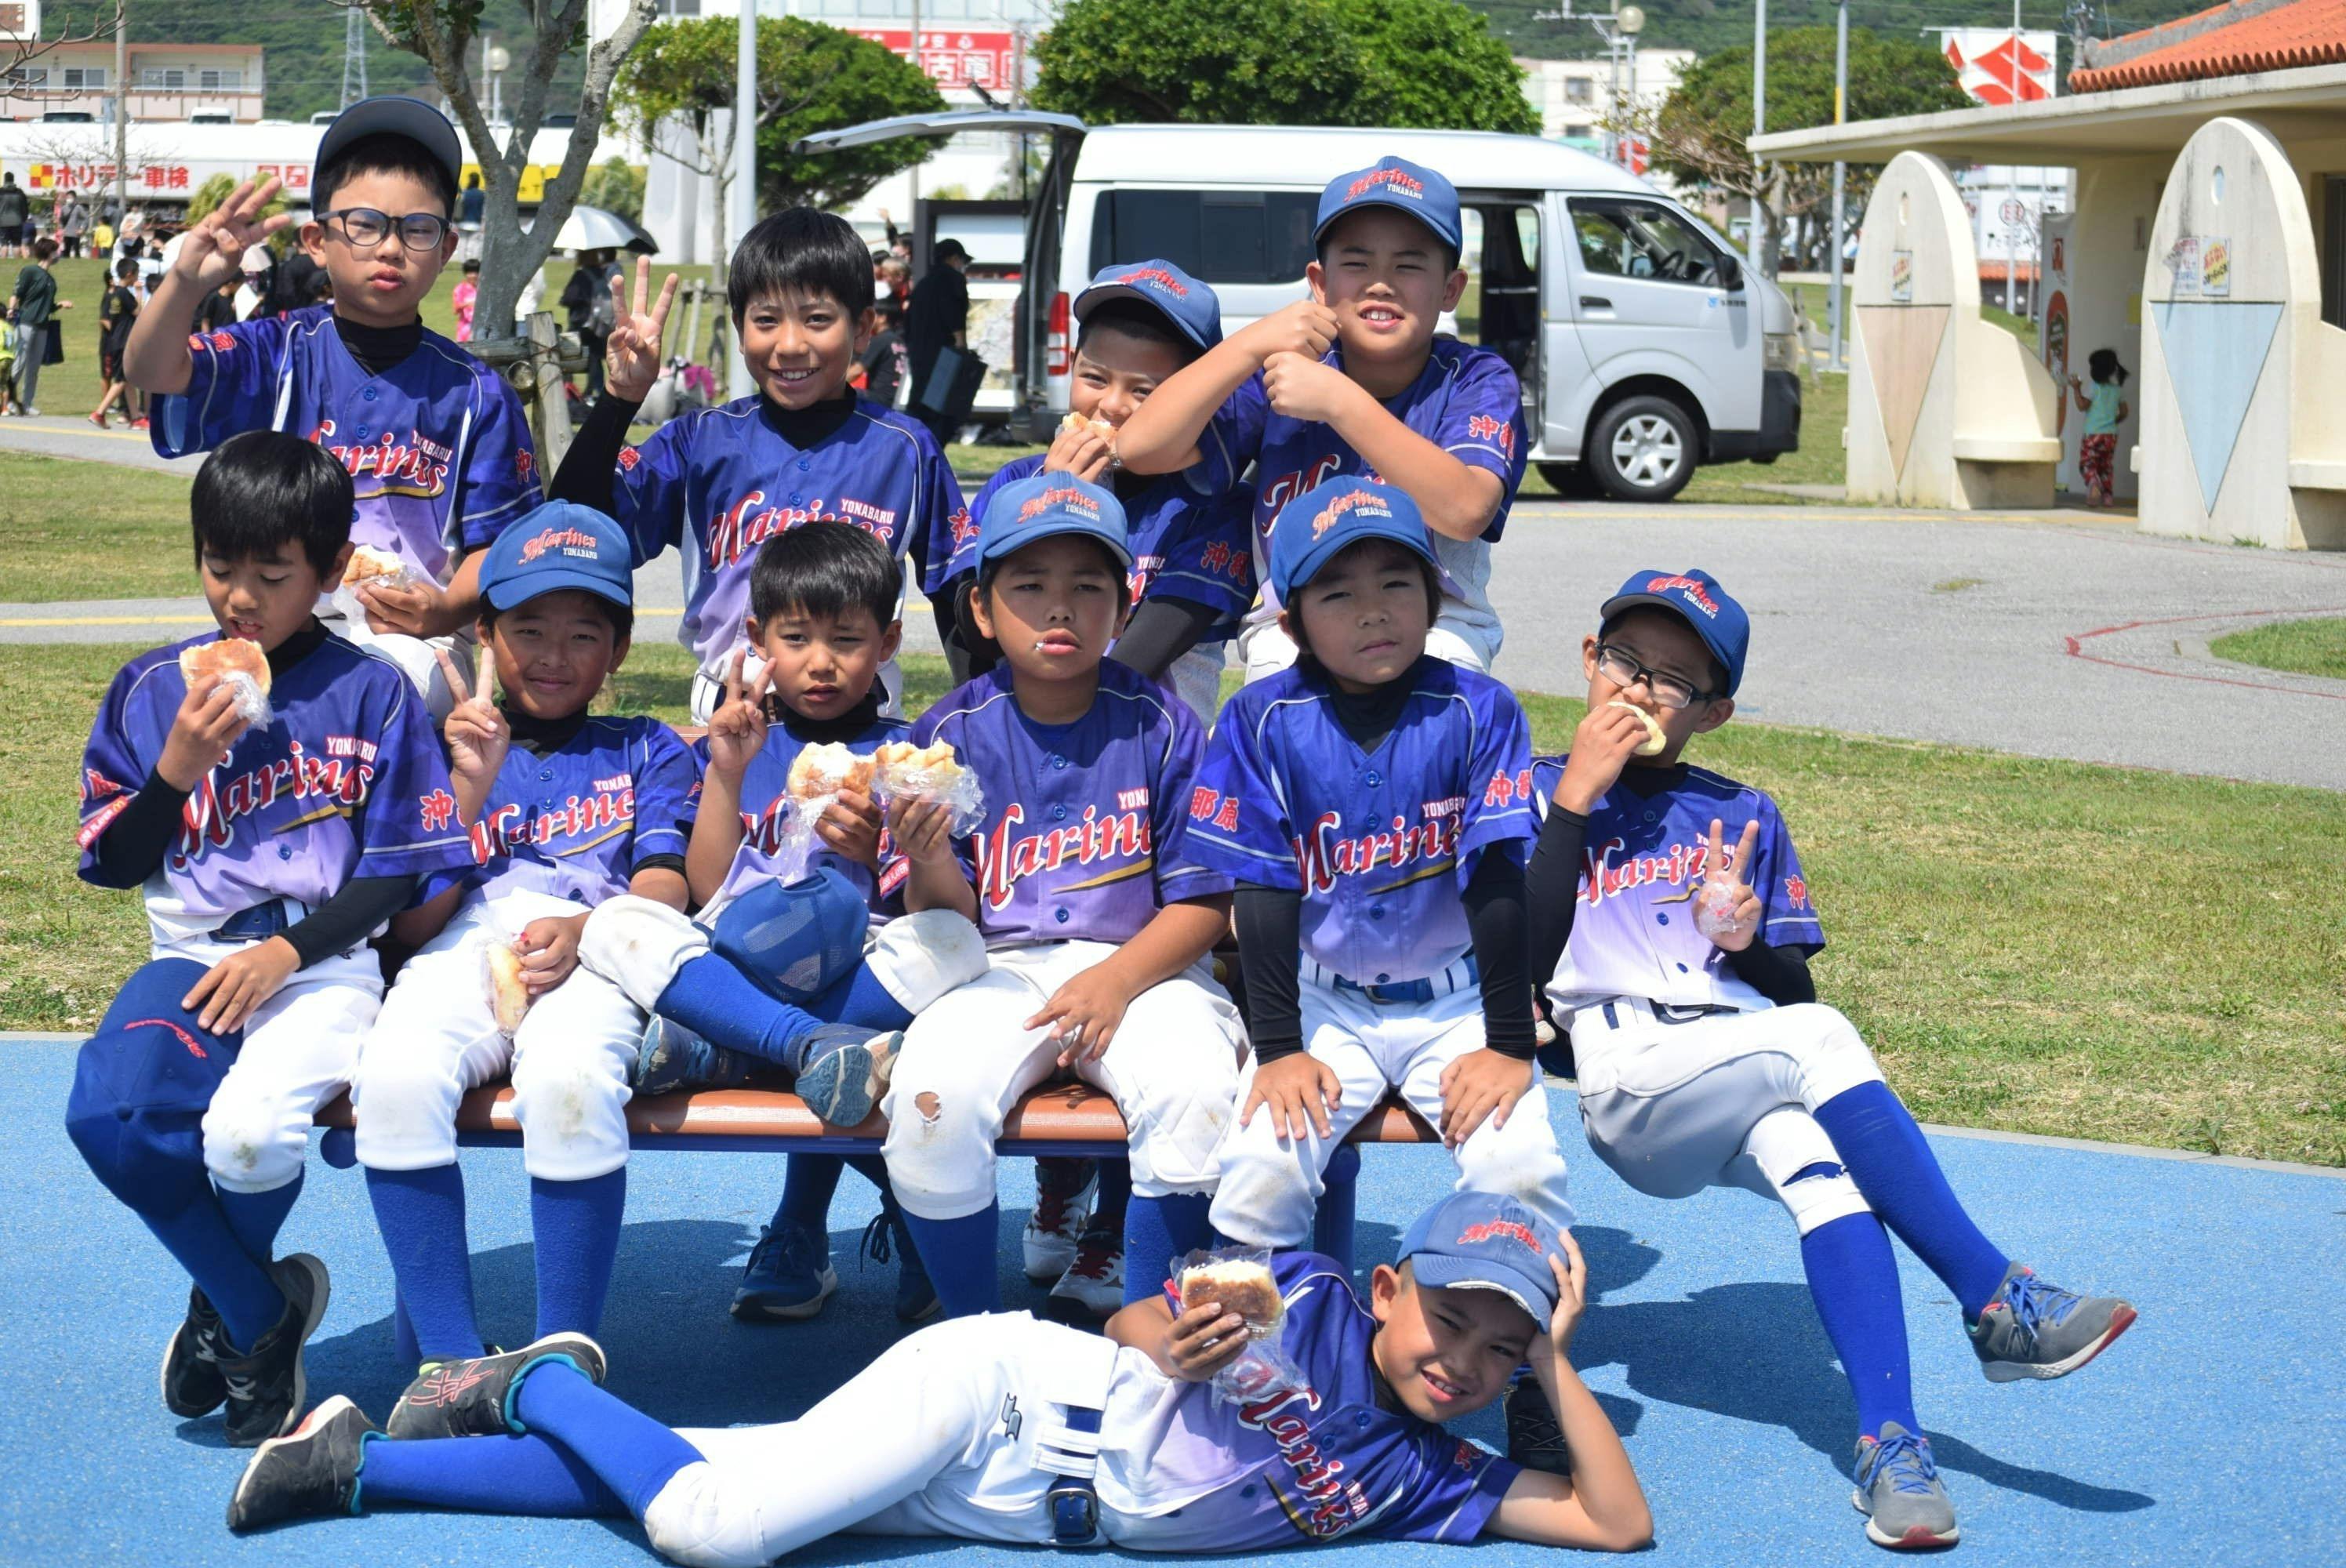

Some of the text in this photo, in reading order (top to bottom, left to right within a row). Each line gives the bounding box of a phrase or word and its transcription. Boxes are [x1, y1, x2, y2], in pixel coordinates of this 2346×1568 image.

[841, 498, 895, 525] YONABARU
[518, 527, 597, 566] Marines
[562, 546, 598, 560] YONABARU
